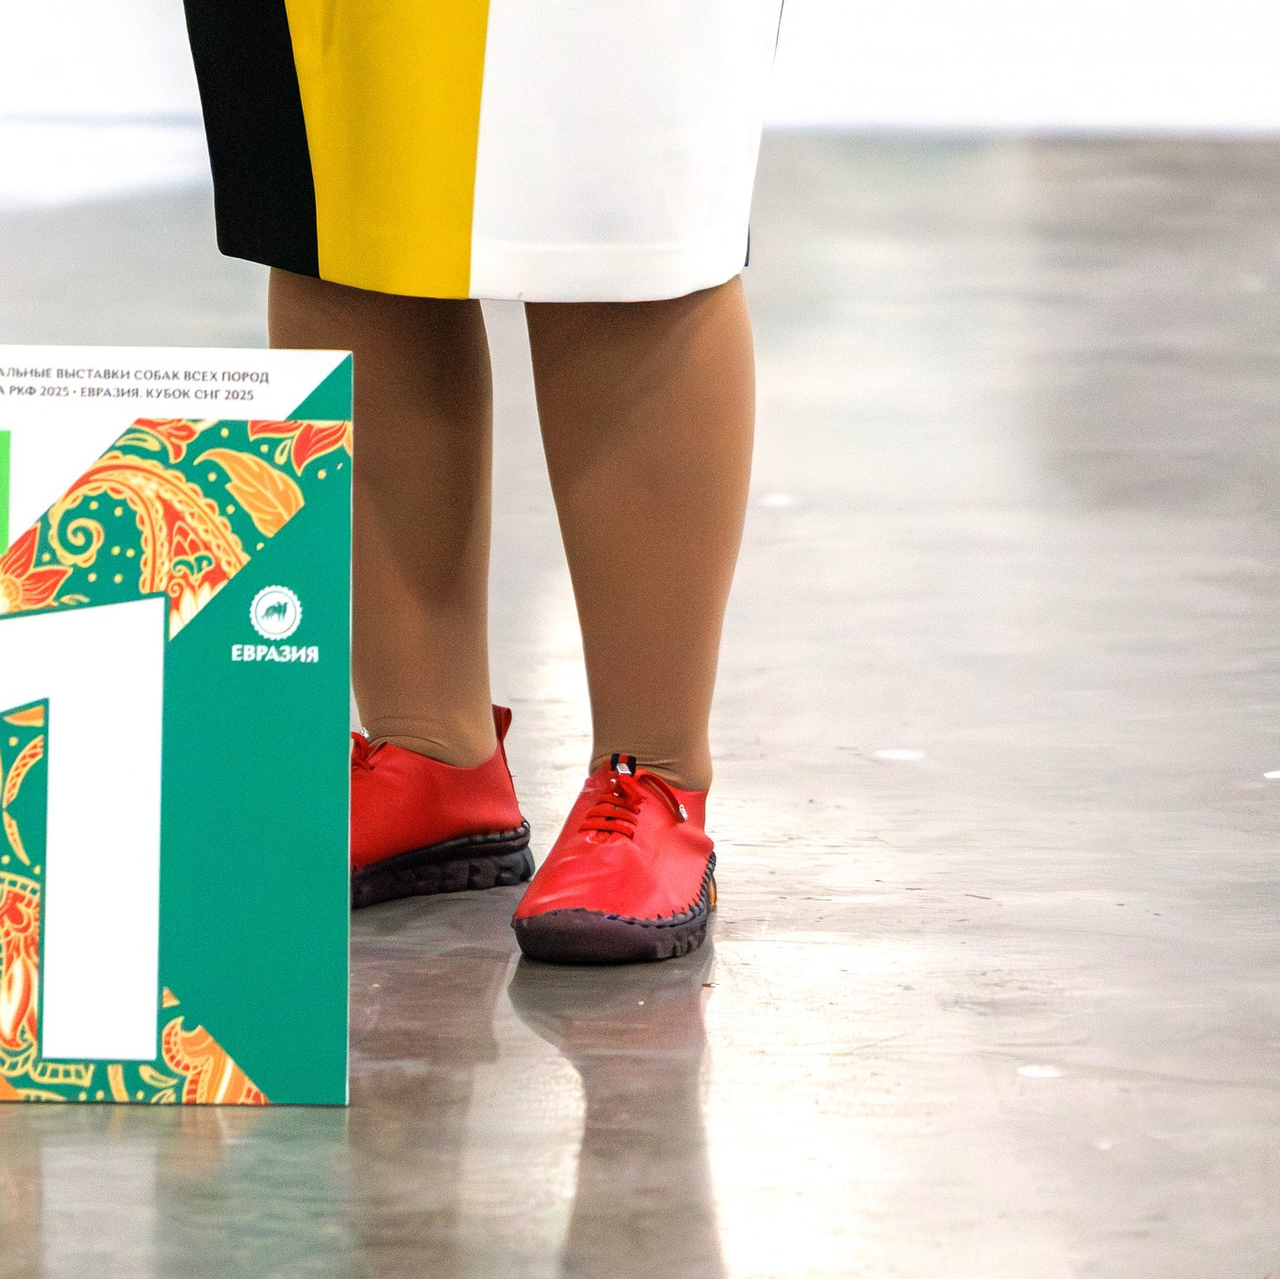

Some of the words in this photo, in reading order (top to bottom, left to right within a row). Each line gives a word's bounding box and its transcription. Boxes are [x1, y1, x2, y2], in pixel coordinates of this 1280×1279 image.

[56, 368, 131, 380] ВЫСТАВКИ
[134, 369, 181, 381] СОБАК
[184, 370, 218, 382] ВСЕХ
[222, 371, 270, 384] ПОРОД
[9, 384, 37, 396] РКФ
[40, 386, 70, 397] 2025
[80, 386, 143, 398] ЕВРАЗИЯ.
[146, 387, 191, 399] КУБОК
[194, 388, 221, 400] СНГ
[224, 389, 255, 401] 2025
[231, 643, 319, 664] ЕВРАЗИЯ
